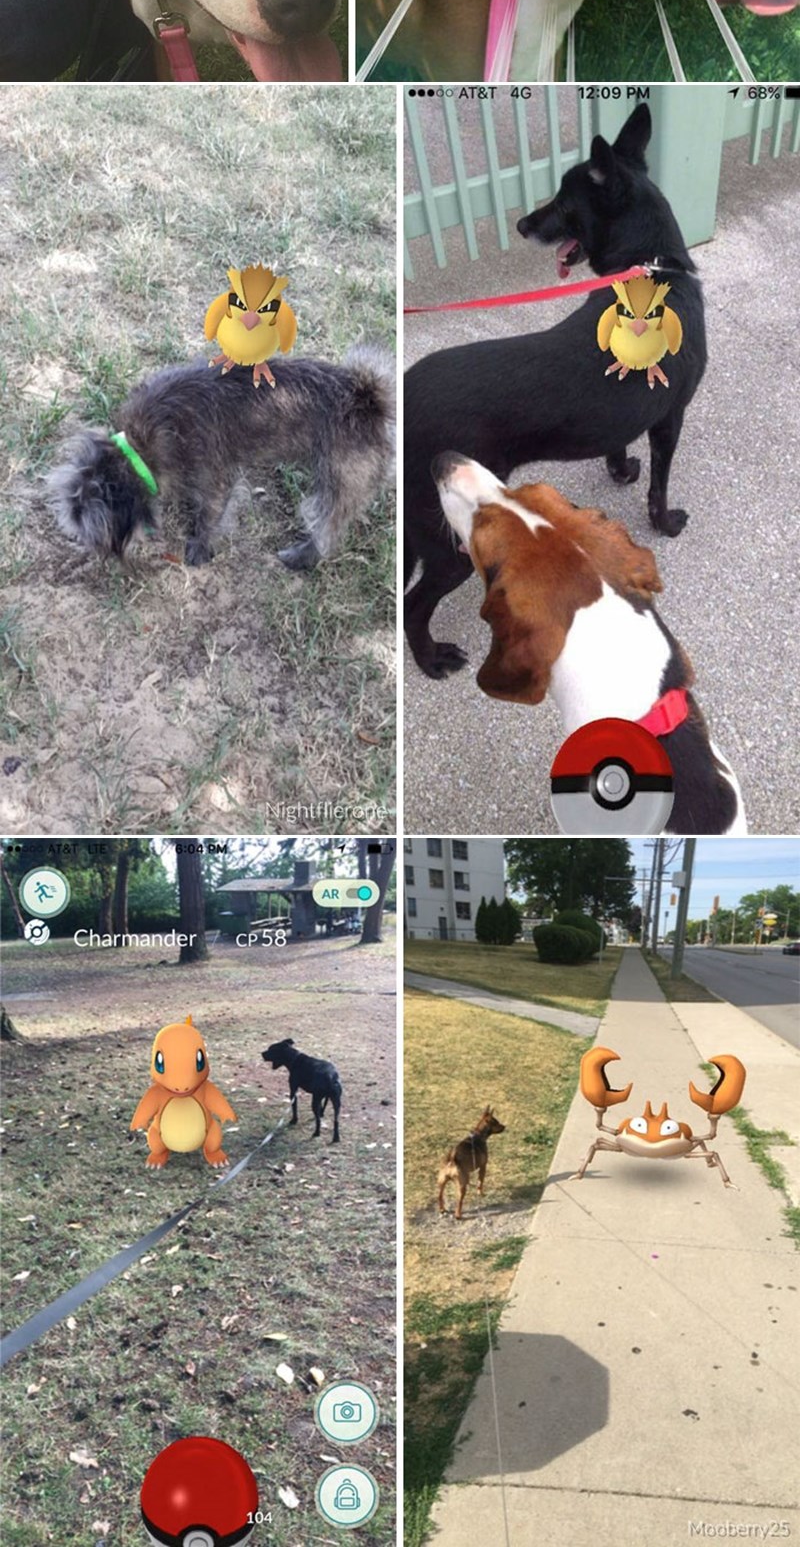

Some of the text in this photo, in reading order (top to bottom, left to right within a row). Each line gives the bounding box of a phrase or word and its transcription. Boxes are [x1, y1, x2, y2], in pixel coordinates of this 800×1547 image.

[458, 87, 532, 100] AT&T 4G
[577, 87, 651, 100] 12:09 PM
[747, 87, 781, 100] 68%
[48, 843, 108, 855] AT&T LTE
[175, 843, 228, 855] 6:04 PM
[321, 888, 340, 901] AR
[73, 929, 198, 948] Charmander
[235, 929, 287, 947] CP 58
[246, 1511, 273, 1524] 104
